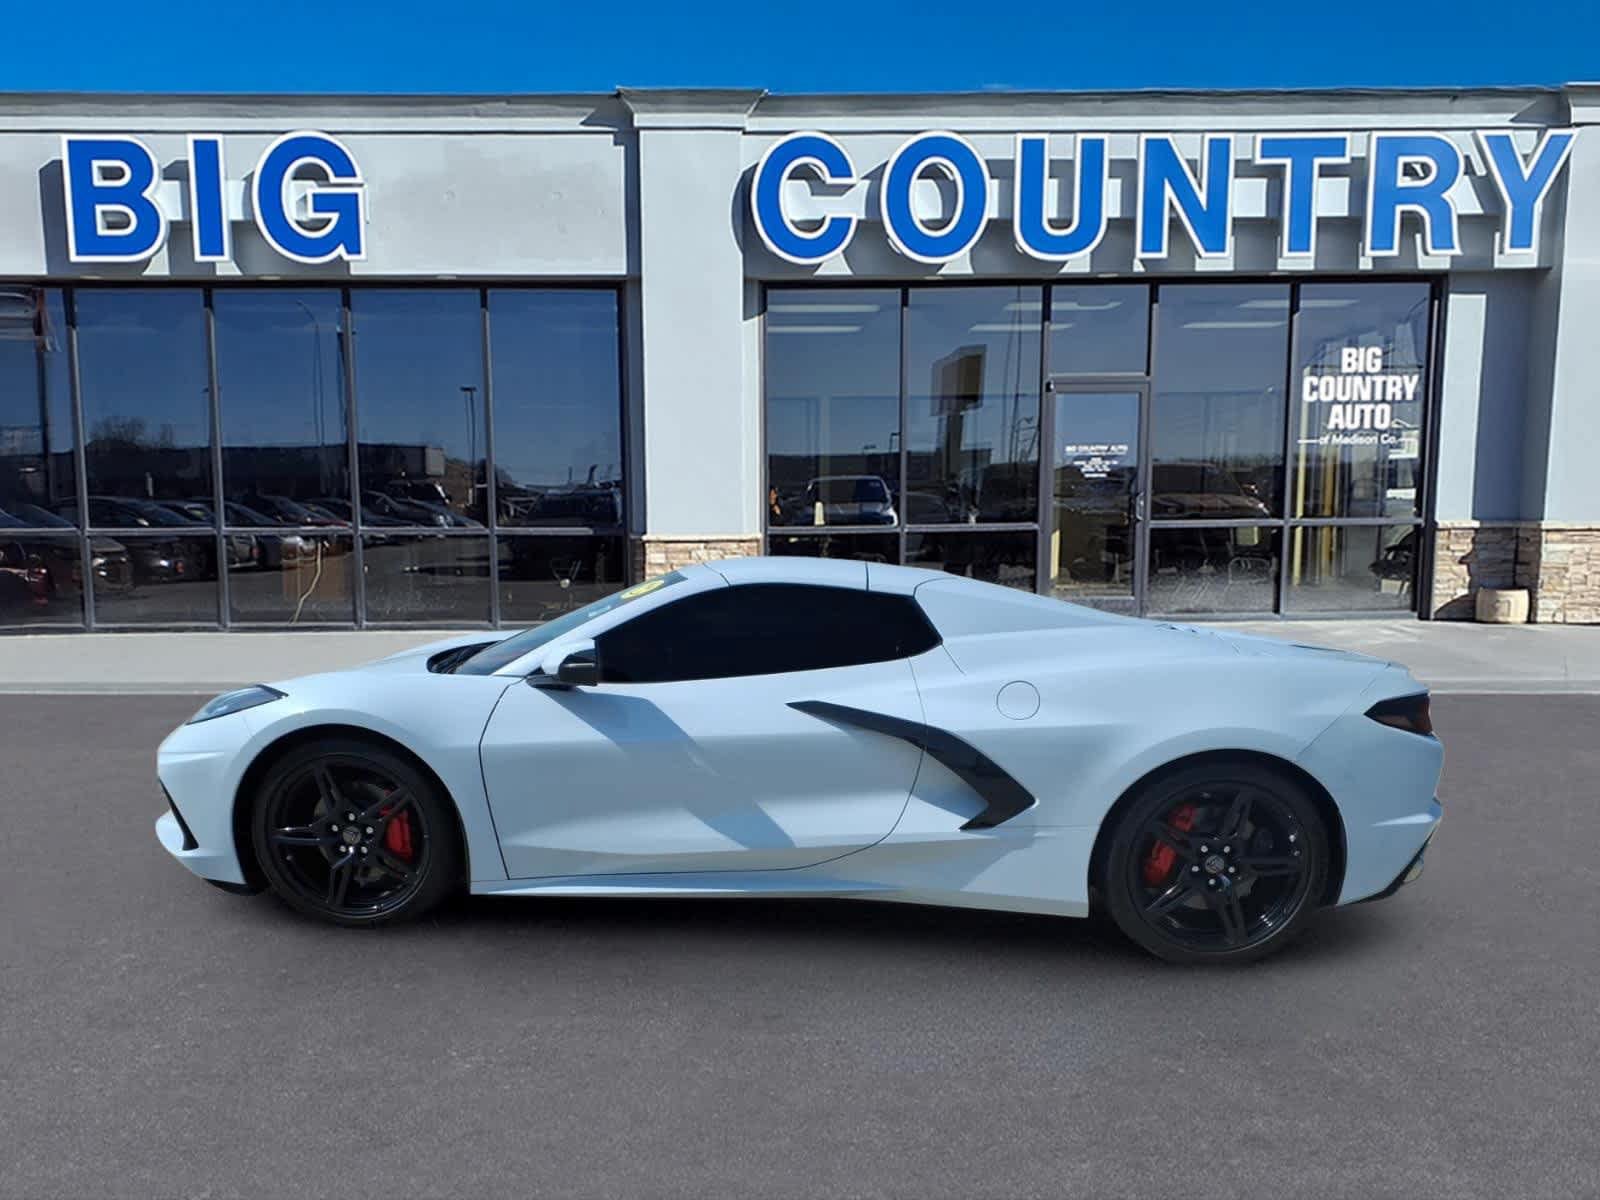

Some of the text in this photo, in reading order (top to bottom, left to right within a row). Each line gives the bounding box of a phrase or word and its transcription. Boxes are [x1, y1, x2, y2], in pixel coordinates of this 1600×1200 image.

[60, 130, 367, 264] BIG
[751, 128, 1574, 267] COUNTRY
[1341, 347, 1383, 374] BIG
[1302, 374, 1419, 402] COUNTRY
[1327, 403, 1392, 430] AUTO
[1331, 433, 1378, 445] Madison
